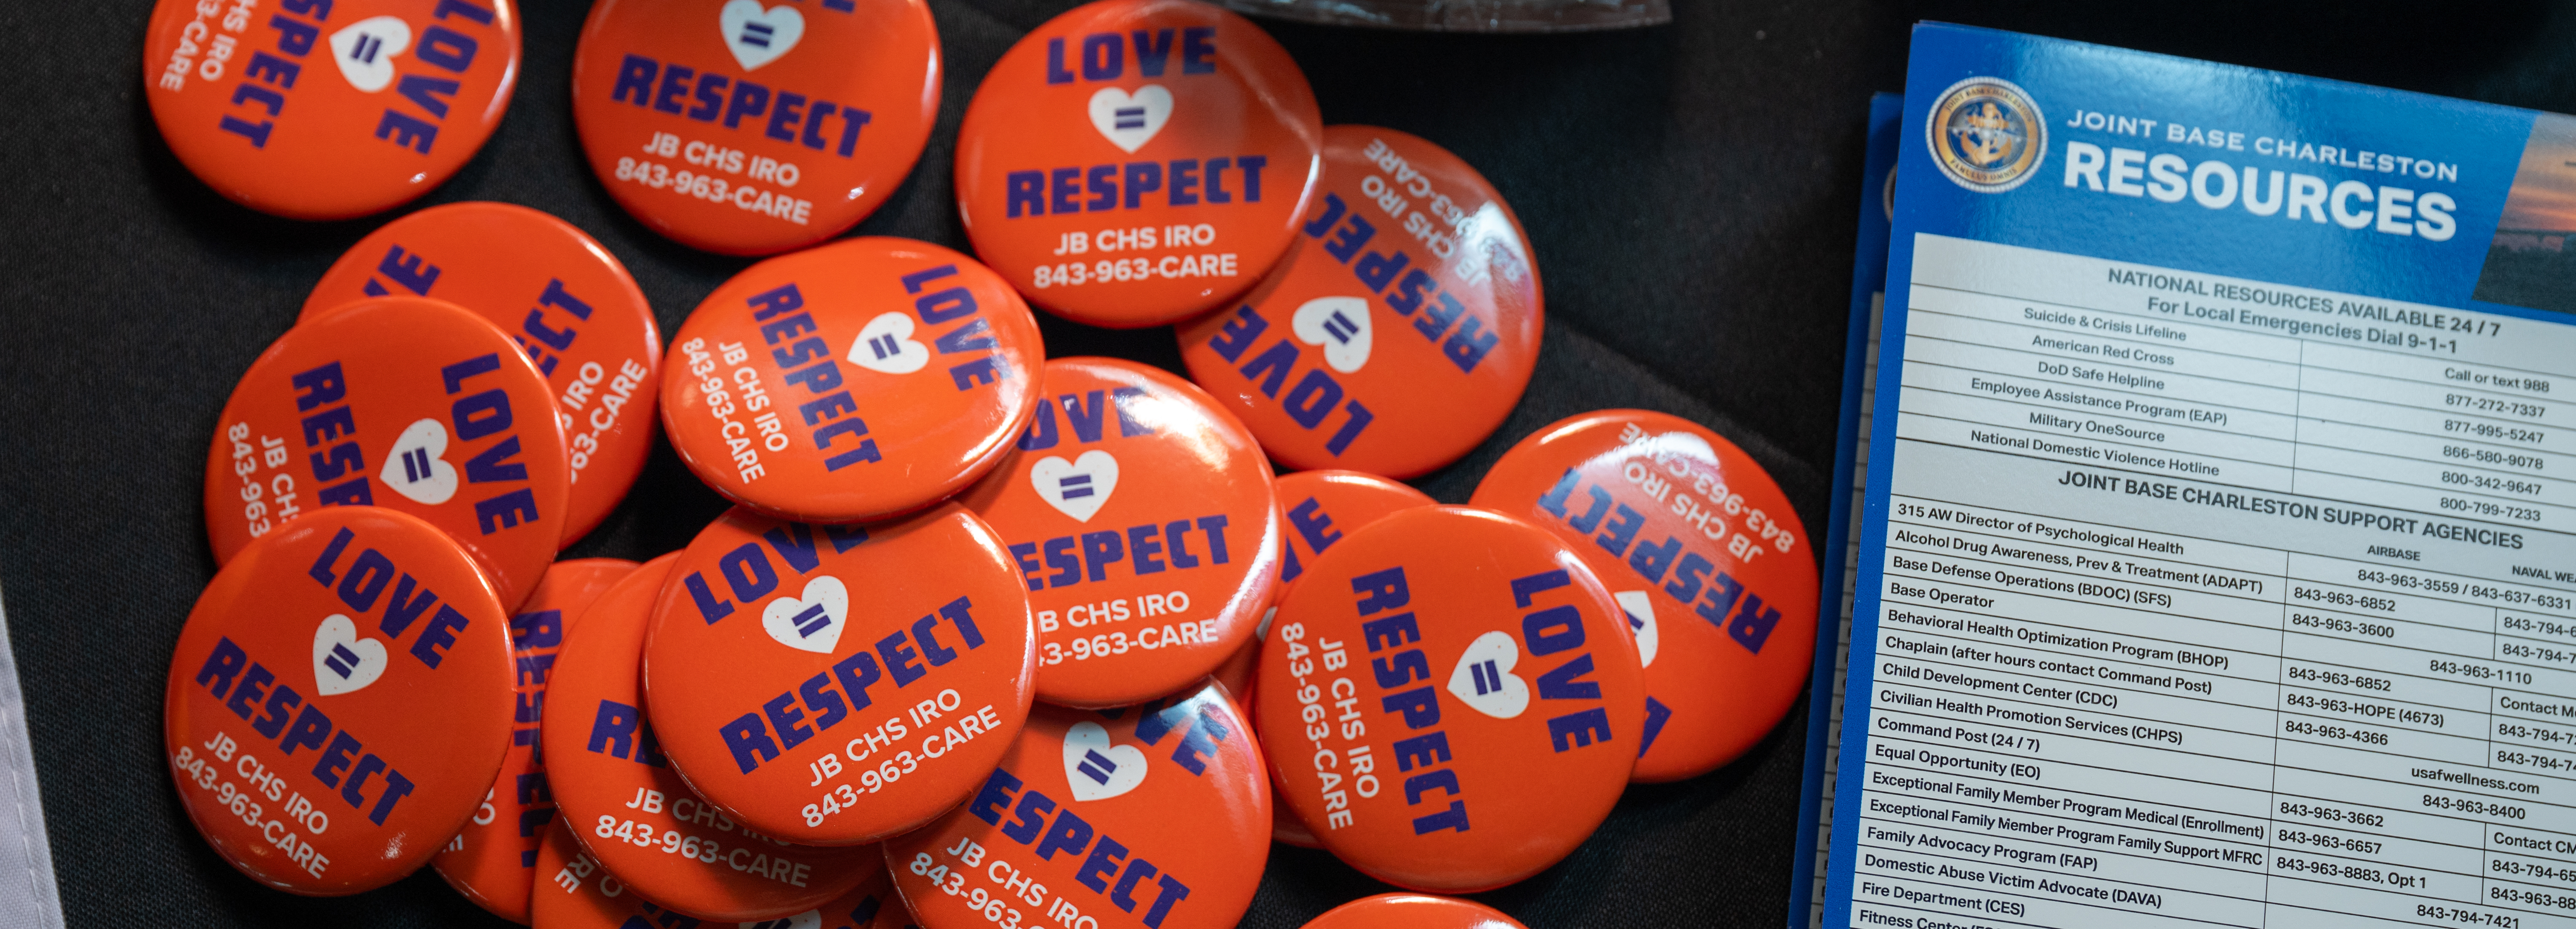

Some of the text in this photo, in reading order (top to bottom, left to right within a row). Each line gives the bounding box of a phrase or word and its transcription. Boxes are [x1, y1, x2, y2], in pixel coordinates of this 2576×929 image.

[200, 34, 236, 80] IRO
[375, 0, 494, 155] LOVE
[1048, 26, 1216, 84] LOVE
[612, 54, 871, 157] RESPECT
[644, 132, 799, 186] JB CHS IRO
[2068, 109, 2457, 182] JOINT BASE CHARLESTON
[616, 158, 811, 224] 843-963-CARE
[1007, 155, 1267, 218] RESPECT
[2064, 141, 2456, 241] RESOURCES
[1055, 224, 1215, 255] JB CHS IRO
[1362, 176, 1491, 287] JB CHS IRO
[1035, 254, 1237, 287] 843-963-CARE
[1304, 193, 1498, 373] RESPEC
[901, 265, 1015, 391] LOVE
[2024, 307, 2186, 341] Suicide & Crisis Lifeline
[2108, 269, 2501, 337] NATIONAL RESOURCES AVAILABLE 24 / 7
[2148, 296, 2456, 354] For Local Emergencies Dial 9-1-1
[563, 362, 603, 410] IRO
[719, 342, 788, 451] JB CHS IRO
[748, 284, 881, 471] RESPECT
[1209, 304, 1373, 456] LOVE
[1972, 378, 2227, 426] Employee Assistance Program (EAP)
[2038, 361, 2165, 390] DoD Safe Helpline
[2445, 367, 2549, 393] Call or text 988
[683, 338, 765, 483] 843-963-CARE
[2030, 412, 2165, 442] Military OneSource
[2444, 419, 2544, 443] 877-995-5247
[262, 436, 287, 467] JB
[442, 353, 538, 535] LOVE
[1971, 430, 2220, 476] National Domestic Violence Hotline
[2443, 445, 2543, 470] 866-580-9078
[1623, 462, 1763, 563] JB CHS IRO
[2058, 471, 2523, 550] JOINT BASE CHARLESTON SUPPORT AGENCIES
[2441, 497, 2541, 522] 800-799-7233
[2442, 471, 2542, 495] 800-342-9647
[1008, 515, 1229, 591] ESPECT
[1898, 503, 2184, 555] 315 AW Director of Psychological Health
[2367, 545, 2421, 561] AIRBASE
[1538, 468, 1780, 654] RESPECT
[1895, 530, 2263, 594] Alcohol Drug Awareness, Prev & Treatment (ADAPT)
[2358, 569, 2570, 610] 843-963-3559 / 843-637-6331
[2512, 565, 2552, 580] NAVAL
[309, 527, 469, 669] LOVE
[1067, 591, 1189, 627] CHS IRO
[1891, 582, 1994, 608] Base Operator
[2294, 587, 2395, 612] 843-963-6852
[1040, 618, 1222, 666] 3-963-CARE
[1511, 566, 1612, 752] LOVE
[1886, 636, 2212, 695] Chaplain (after hours contact Command Post)
[2430, 659, 2532, 685] 843-963-1110
[719, 596, 985, 774] RESPECT
[1351, 567, 1469, 835] RESPECT
[2287, 694, 2444, 728] 843-963-HOPE (4673)
[196, 637, 414, 826] RESPECT
[810, 689, 960, 786] JB CHS IRO
[1282, 622, 1352, 829] 843-963-CARE
[1320, 638, 1379, 797] JB CHS IRO
[205, 732, 328, 834] JB CHS IRO
[802, 705, 1000, 827] 843-963-CARE
[1876, 744, 2040, 780] Equal Opportunity (EO)
[2412, 768, 2539, 794] usafwellness.com
[176, 746, 329, 878] 843-963-CARE
[626, 788, 733, 831] JB CHS
[2280, 802, 2383, 827] 843-963-3662
[595, 815, 810, 887] 843-963-CARE
[968, 767, 1190, 929] ESPECT
[947, 837, 1098, 929] JB CHS IRO
[1865, 854, 2162, 909] Domestic Abuse Victim Advocate (DAVA)
